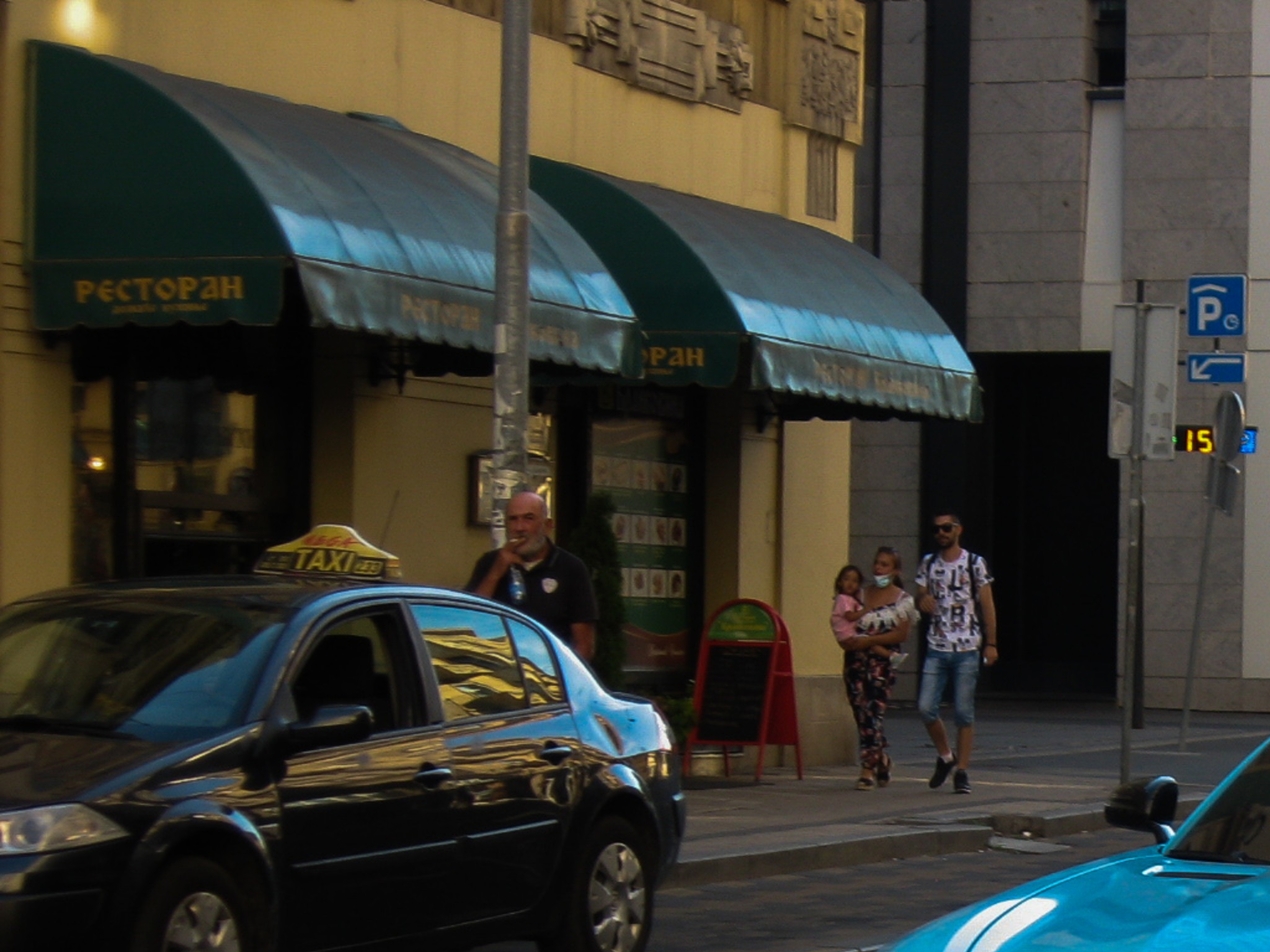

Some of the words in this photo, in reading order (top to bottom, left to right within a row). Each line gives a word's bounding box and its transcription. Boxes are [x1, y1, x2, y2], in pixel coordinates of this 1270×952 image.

[1197, 296, 1222, 331] P
[1186, 429, 1213, 453] 15
[295, 549, 356, 572] TAXI
